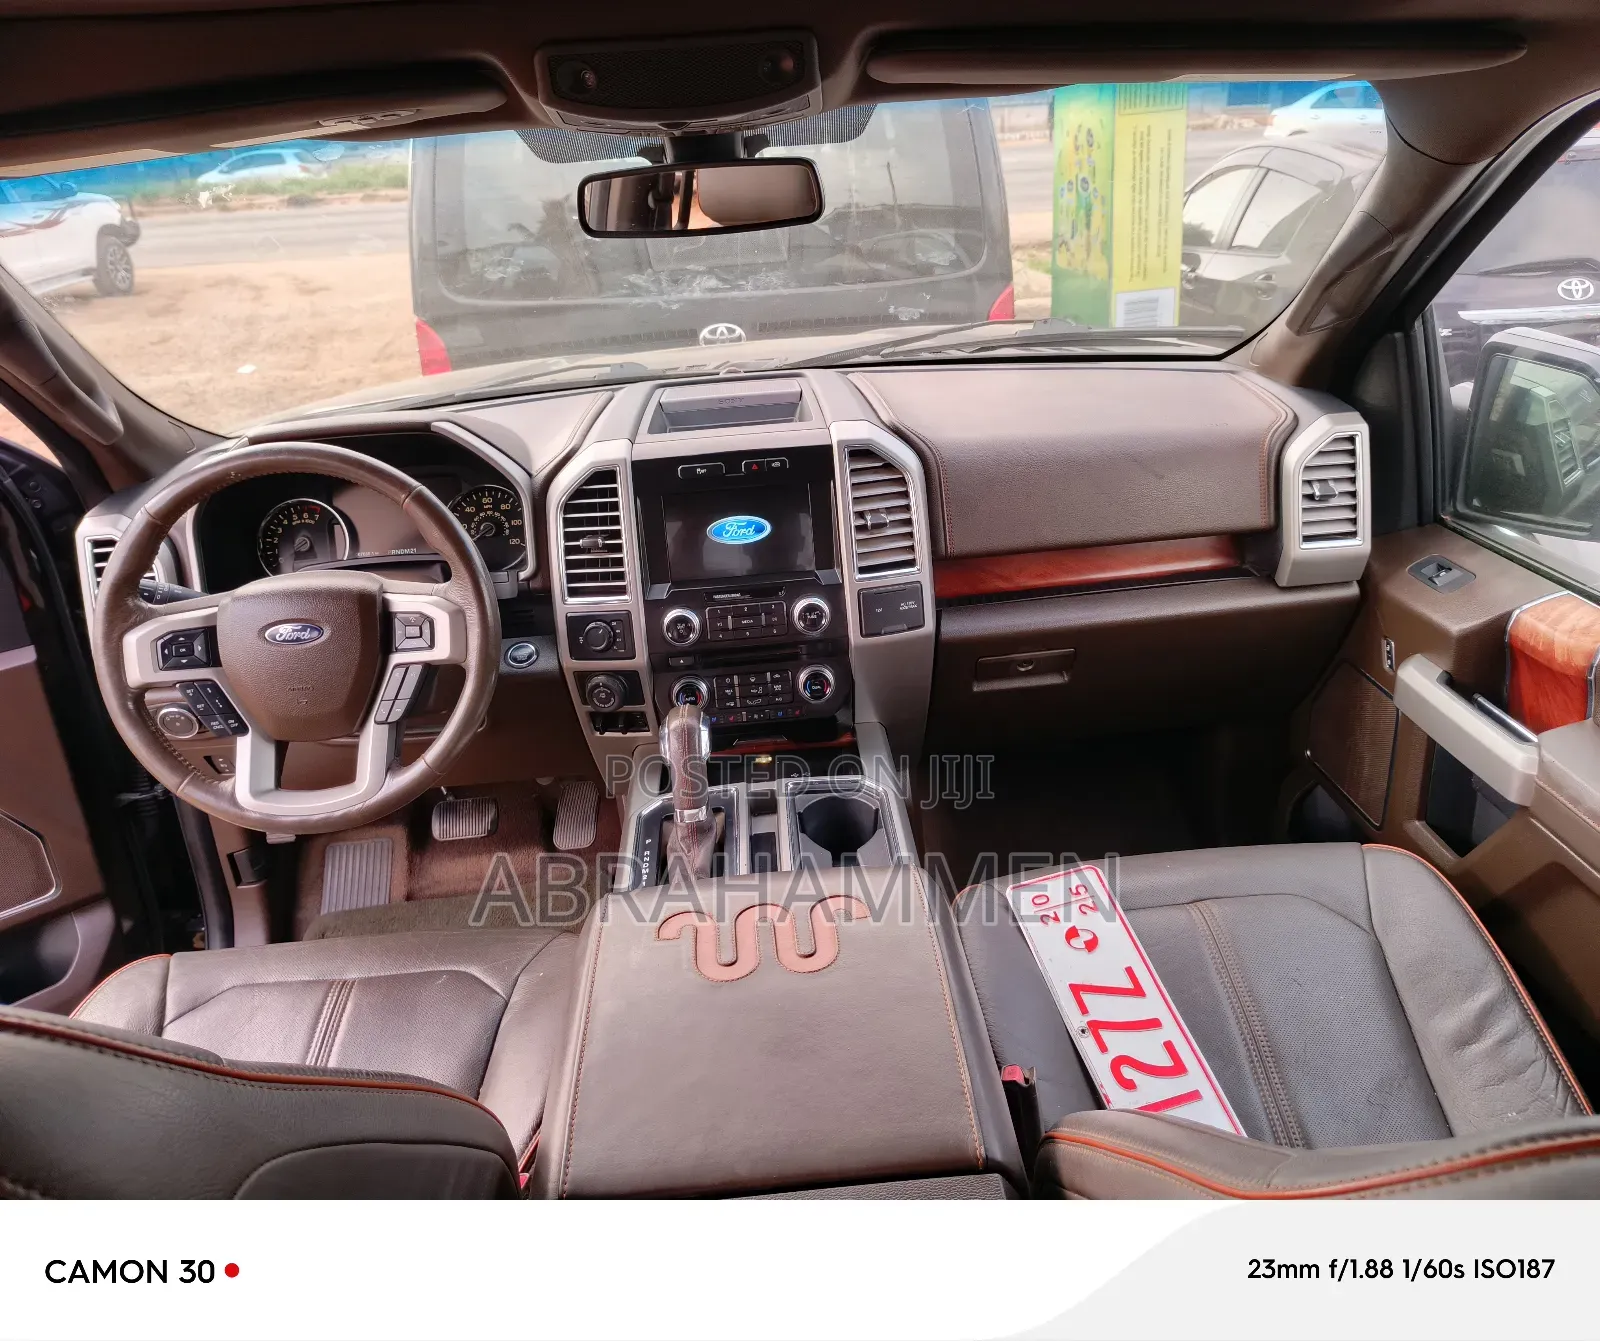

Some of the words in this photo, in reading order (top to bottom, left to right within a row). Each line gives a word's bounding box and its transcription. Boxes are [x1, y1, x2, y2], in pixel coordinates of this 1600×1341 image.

[722, 521, 756, 538] Ford
[275, 625, 311, 641] Ford
[1031, 893, 1061, 927] 20
[1068, 883, 1099, 917] 25
